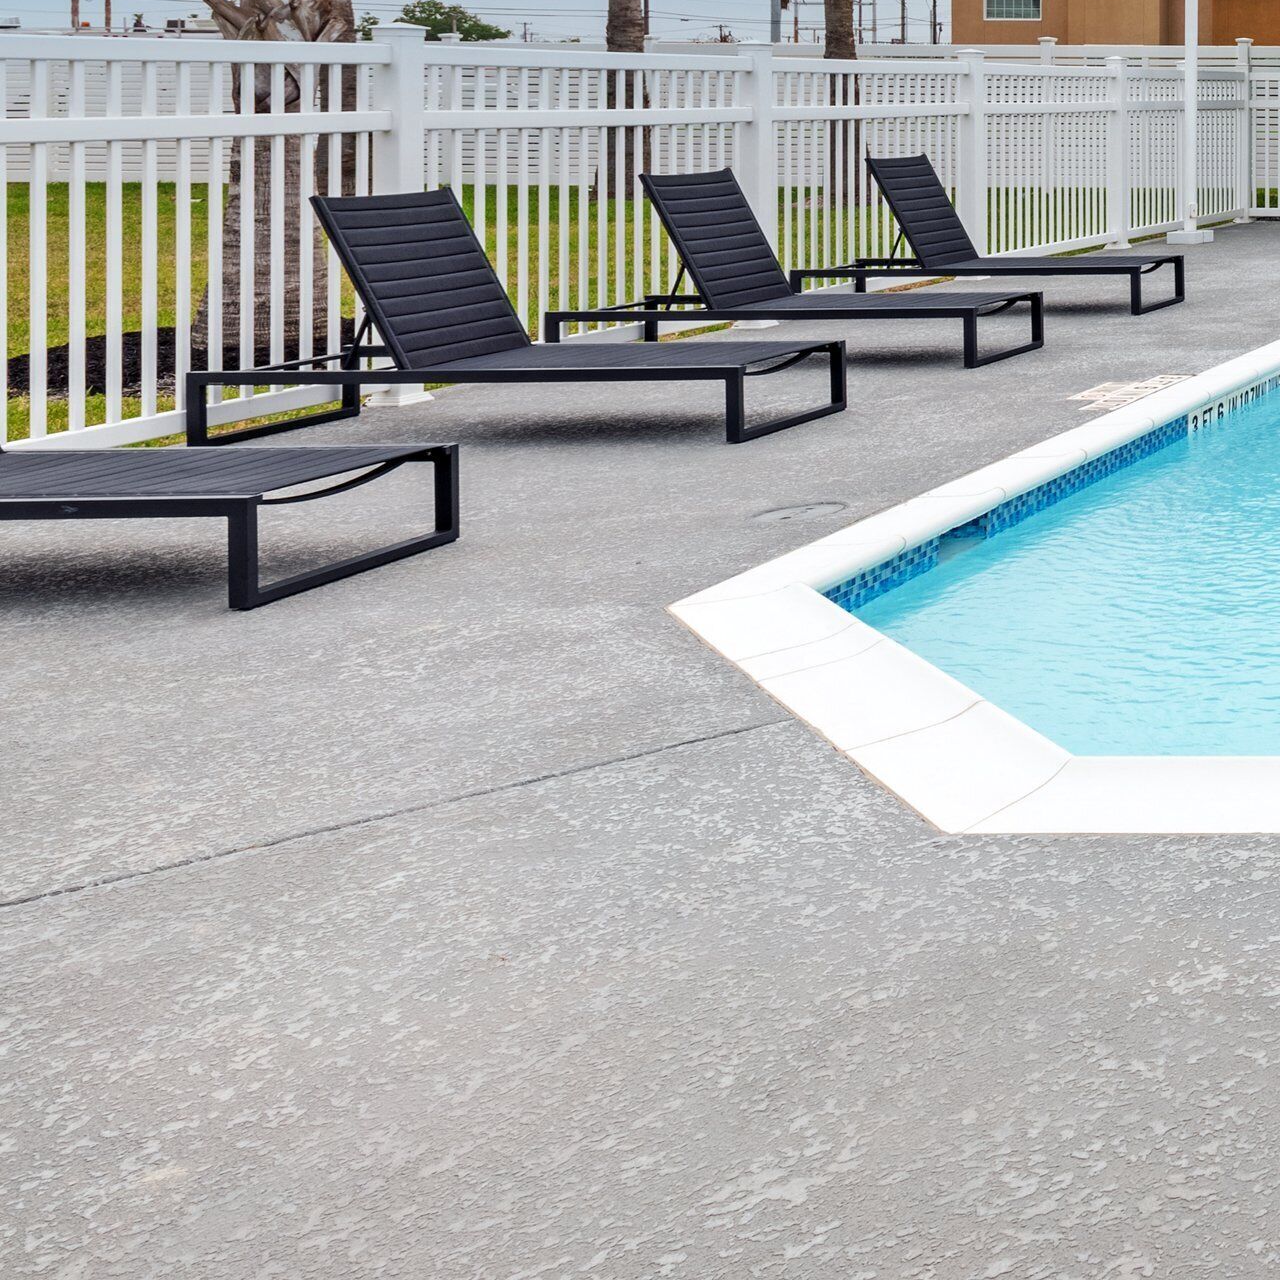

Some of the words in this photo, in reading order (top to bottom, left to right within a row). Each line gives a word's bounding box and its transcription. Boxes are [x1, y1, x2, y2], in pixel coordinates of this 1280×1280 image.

[1192, 415, 1198, 432] 3
[1203, 407, 1213, 427] FT
[1217, 402, 1224, 419] 6
[1228, 395, 1238, 414] IN
